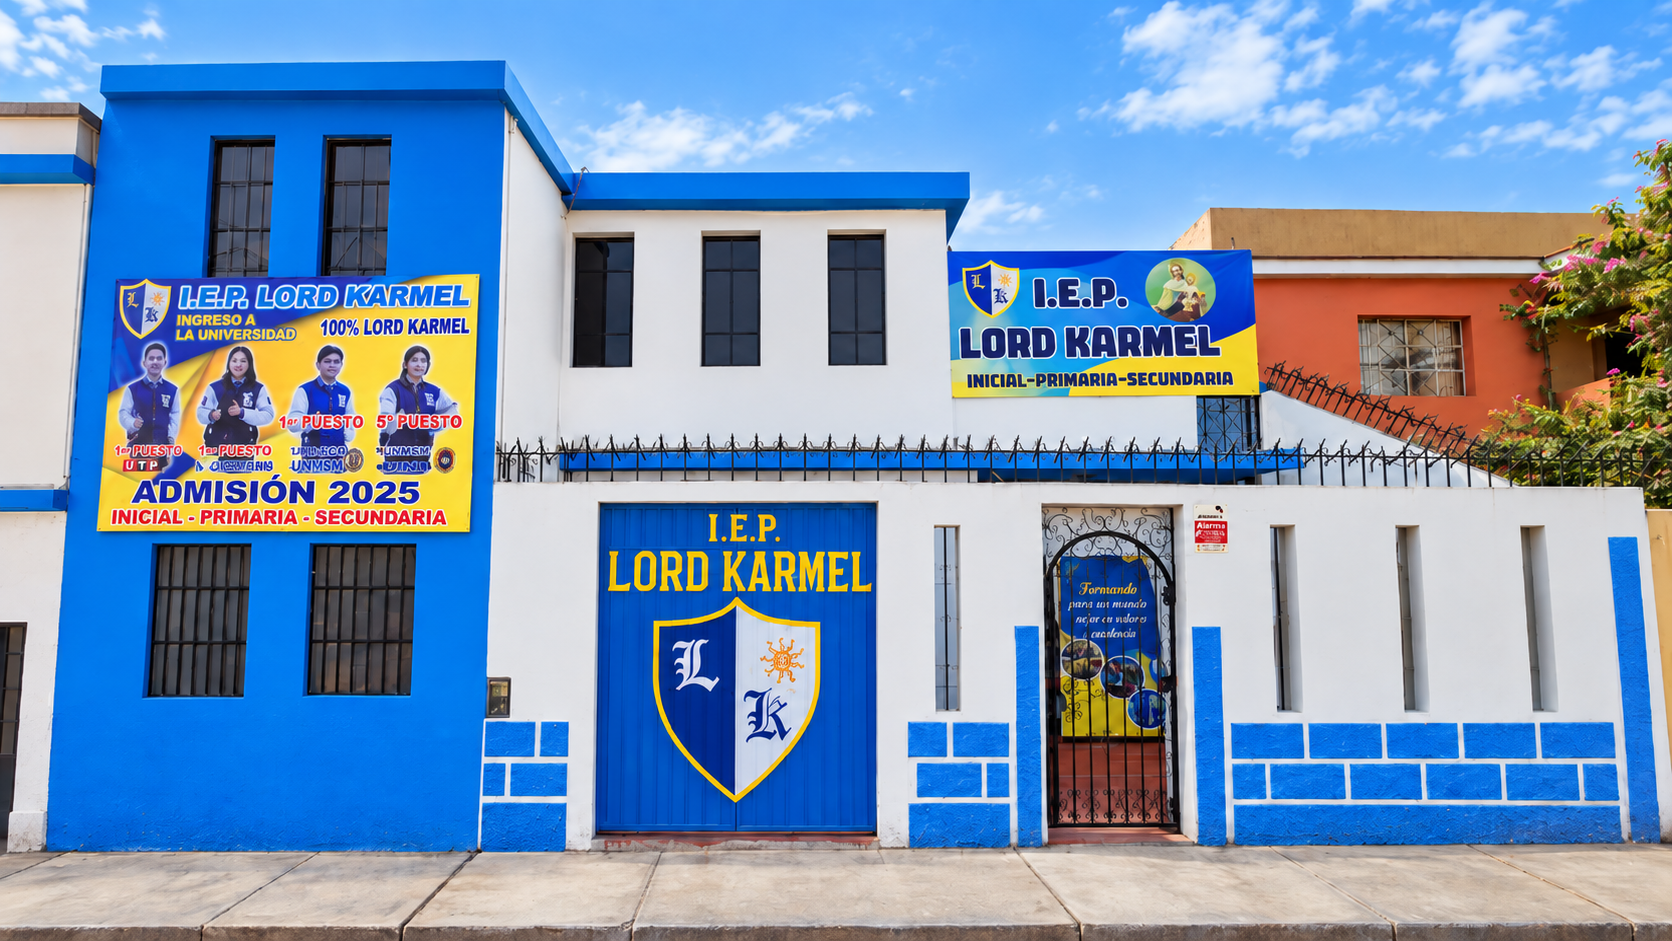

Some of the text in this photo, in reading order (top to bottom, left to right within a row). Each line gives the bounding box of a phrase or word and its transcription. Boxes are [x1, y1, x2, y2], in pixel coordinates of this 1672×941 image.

[178, 284, 471, 310] I.E.P. LORD KARMEL
[1032, 277, 1129, 309] I.E.P.
[176, 314, 256, 326] INGRESO A
[320, 317, 470, 337] 100% LORD KARMEL
[175, 328, 297, 341] LA UNIVERSIDAD
[959, 325, 1221, 359] LORD KARMEL
[967, 371, 1234, 389] INICIAL-PRIMARIA-SECUNDARIA
[397, 414, 463, 429] PUESTO
[133, 445, 183, 457] PUESTO
[219, 445, 272, 457] PUESTO
[126, 460, 158, 471] UTP
[131, 475, 421, 505] ADMISIÓN 2025
[111, 509, 183, 525] INICIAL
[199, 509, 298, 525] PRIMARIA
[315, 509, 448, 526] SECUNDARIA
[708, 513, 781, 543] I.E.P.
[607, 550, 873, 592] LORD KARMEL
[1078, 581, 1138, 596] Formando
